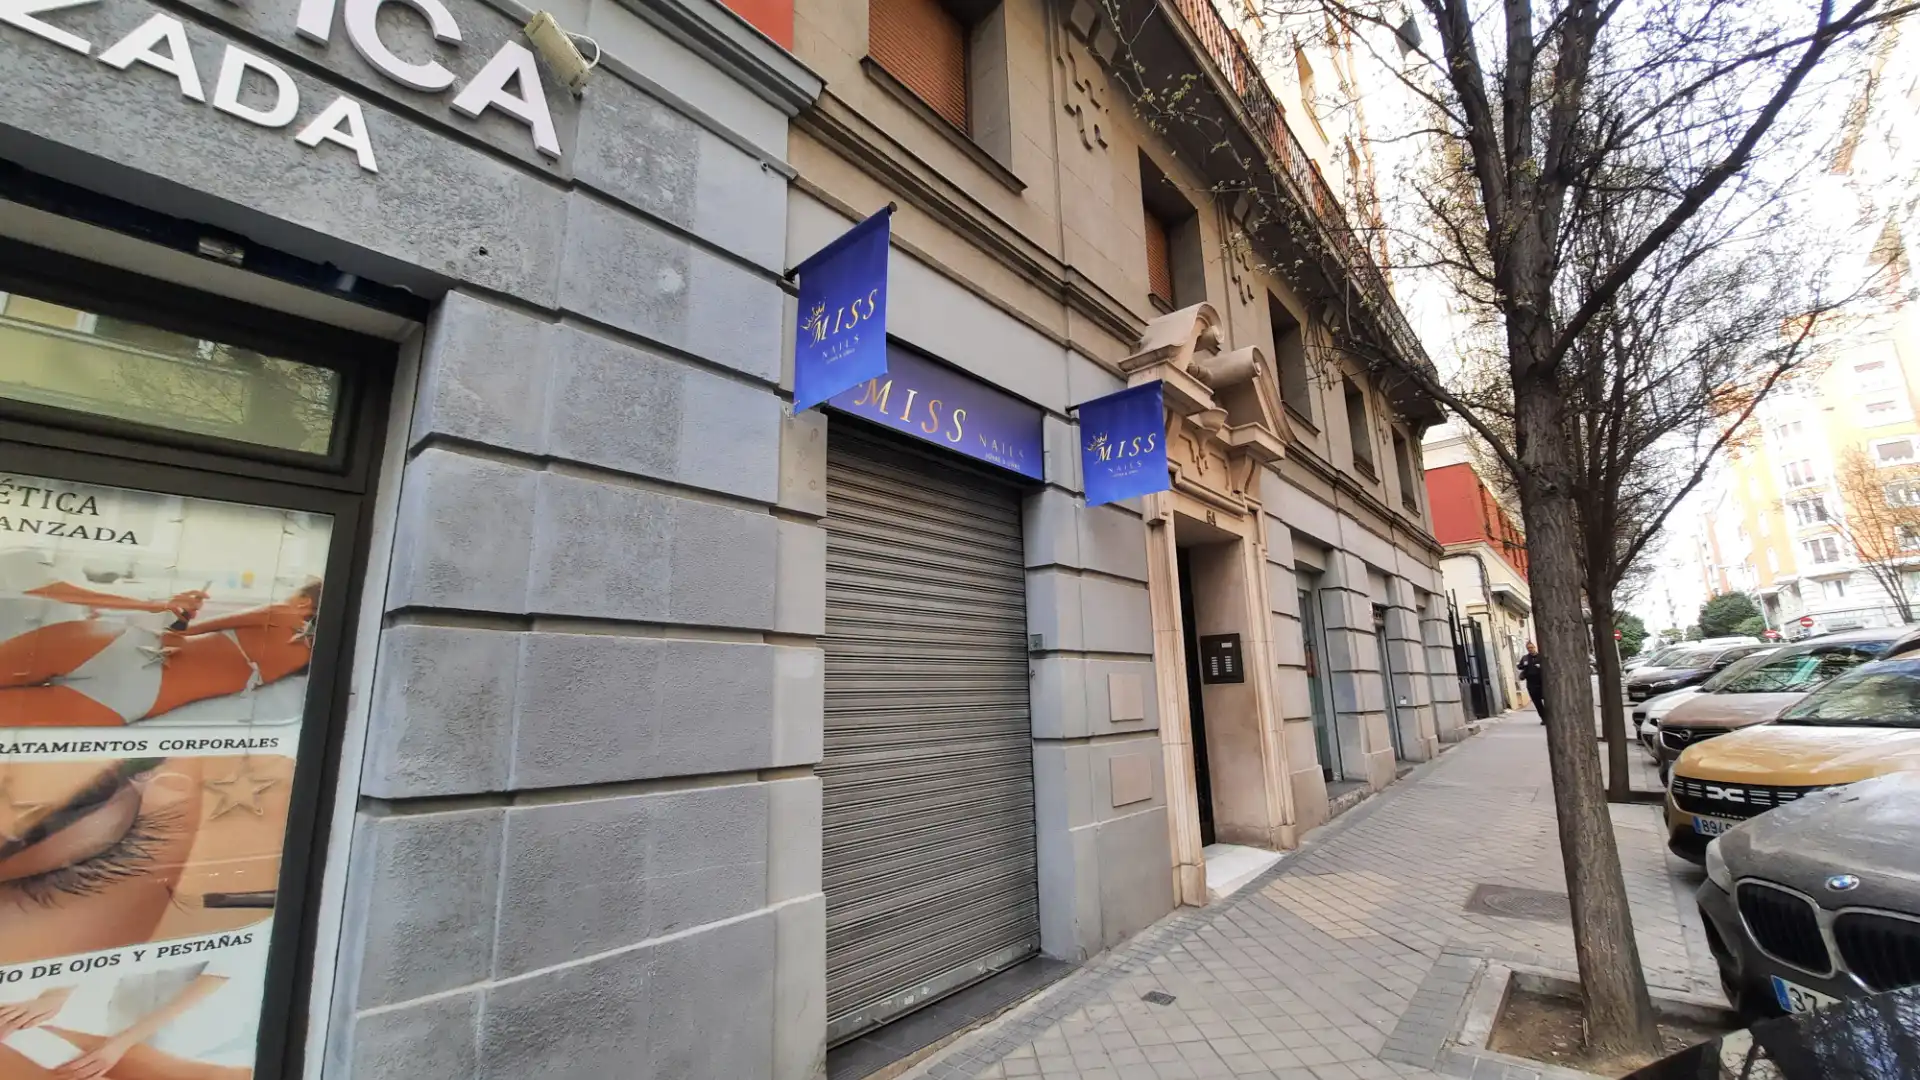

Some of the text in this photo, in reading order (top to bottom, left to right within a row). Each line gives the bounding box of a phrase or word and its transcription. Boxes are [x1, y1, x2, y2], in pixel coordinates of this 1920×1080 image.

[809, 288, 878, 348] MISS
[853, 379, 967, 442] MISS
[1094, 433, 1156, 465] MISS
[159, 738, 279, 751] CORPORALES
[30, 963, 62, 979] DE
[70, 954, 121, 972] OJOS
[134, 950, 146, 962] Y
[157, 933, 254, 959] PESTAÑAS
